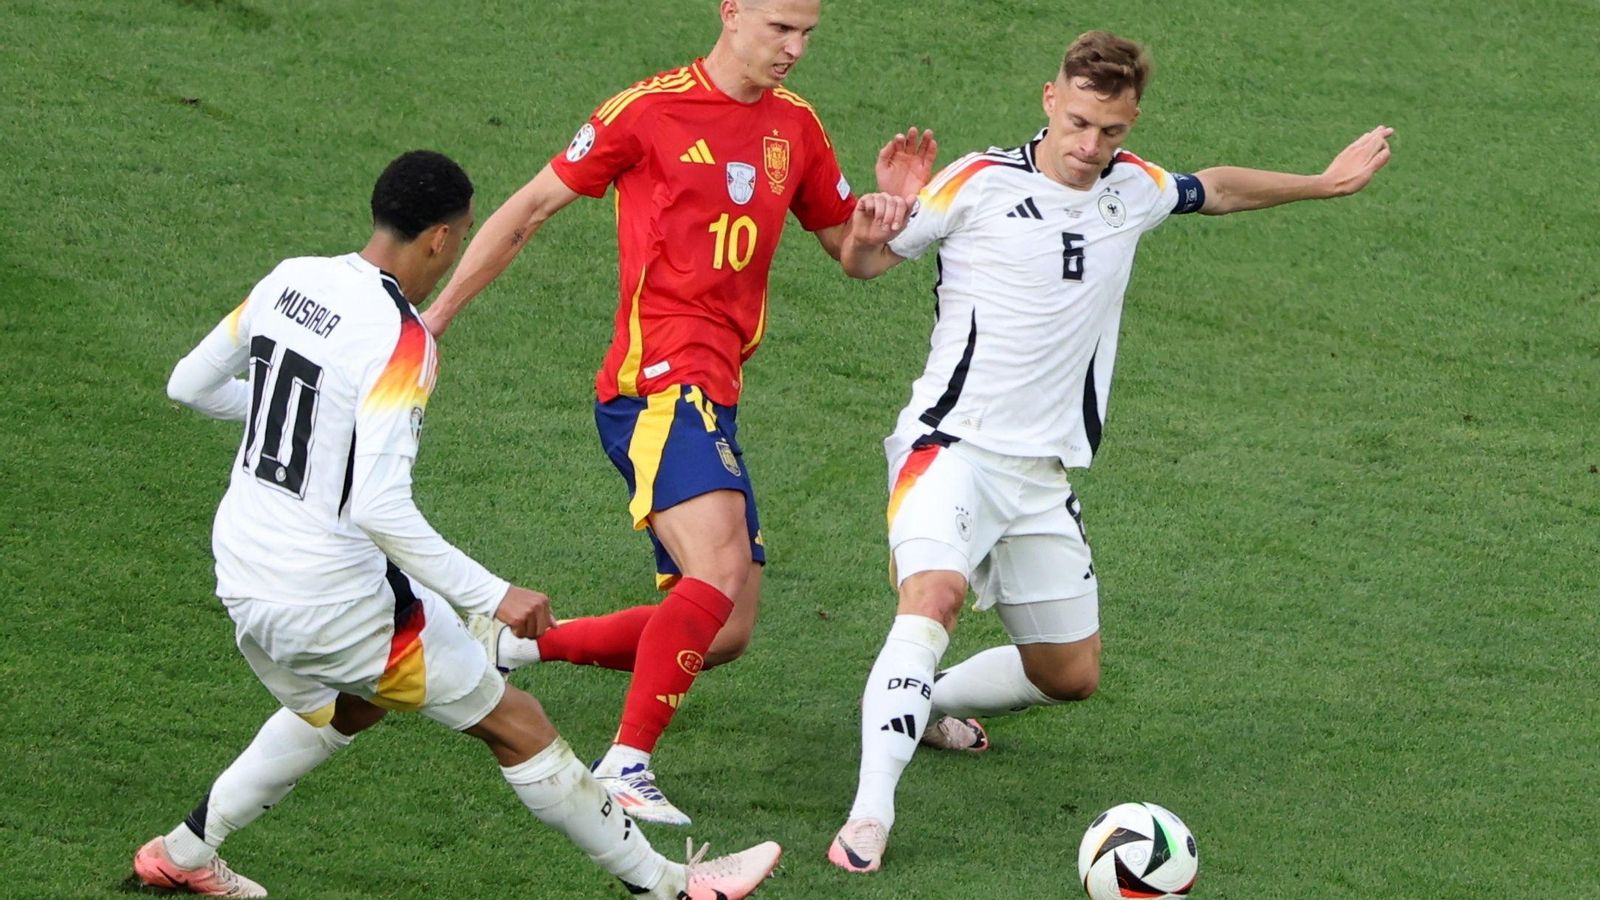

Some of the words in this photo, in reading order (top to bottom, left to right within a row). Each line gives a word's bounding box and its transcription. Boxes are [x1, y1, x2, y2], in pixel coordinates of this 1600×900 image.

[709, 213, 757, 271] 10
[1062, 232, 1086, 283] 6
[274, 286, 341, 339] MUSIALA
[243, 335, 324, 501] 10
[888, 677, 931, 700] DFB
